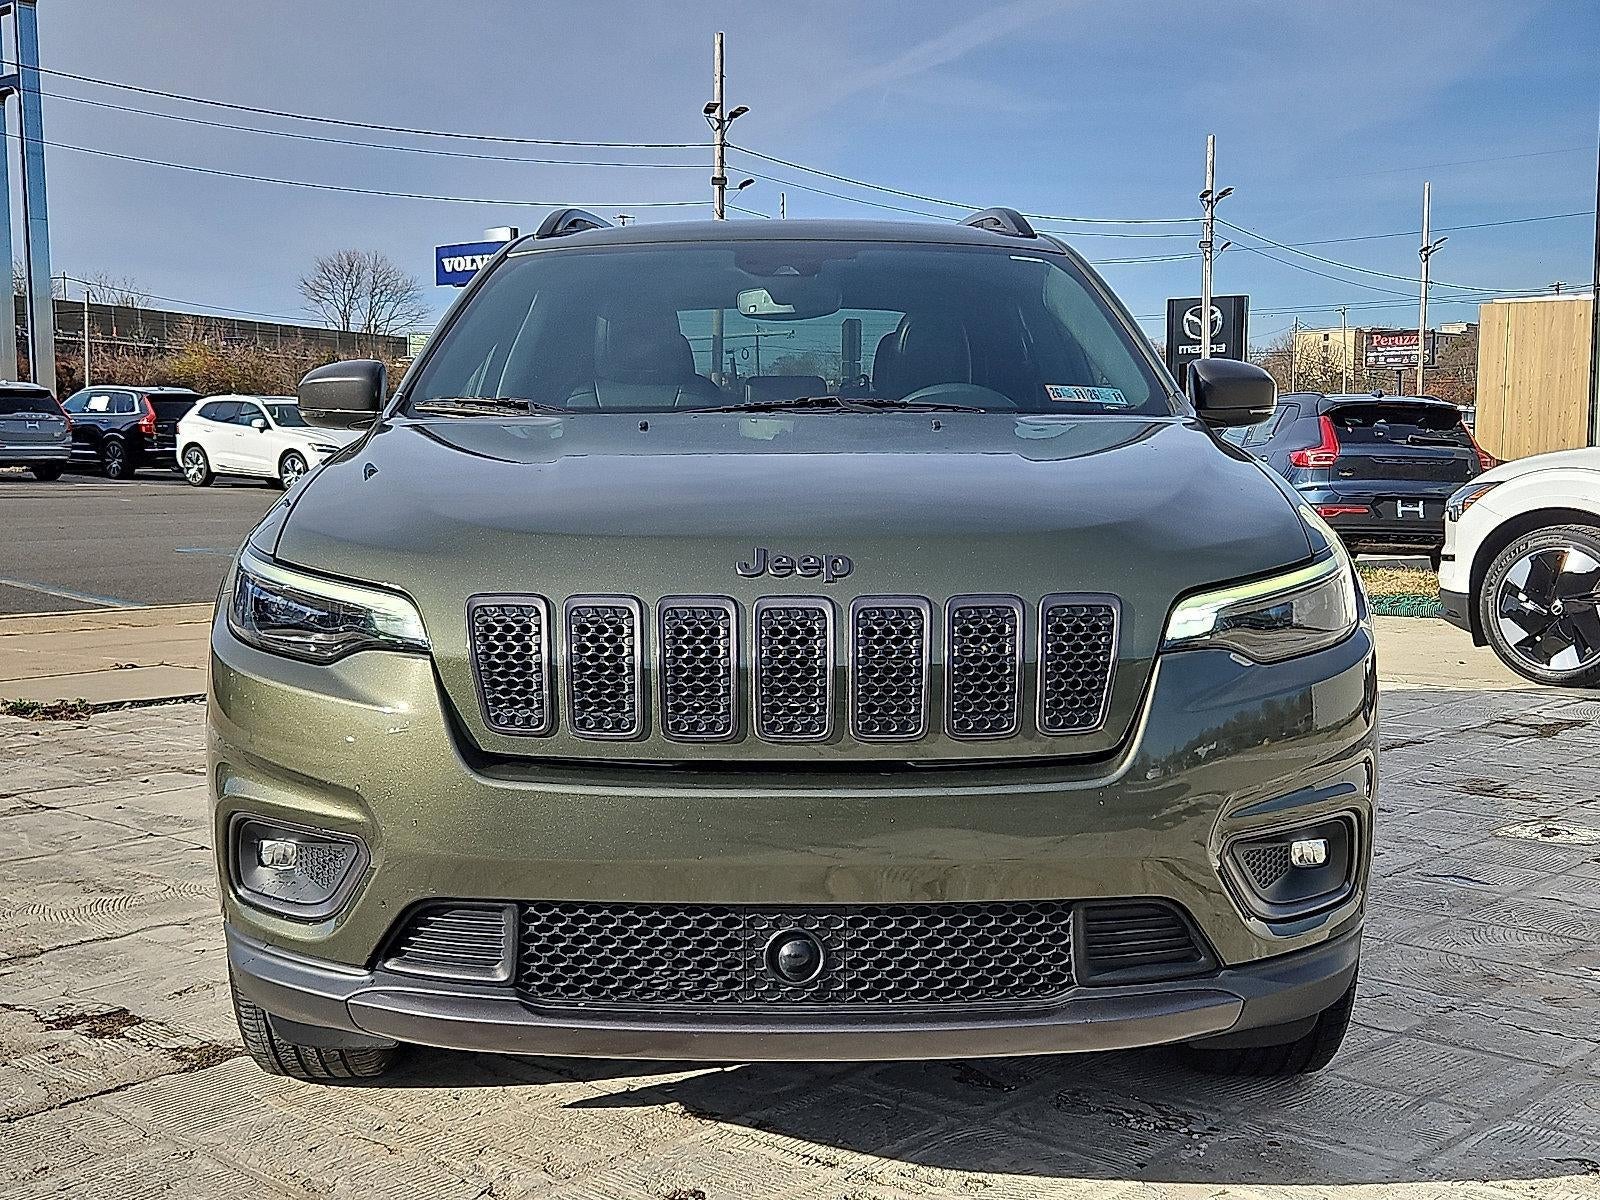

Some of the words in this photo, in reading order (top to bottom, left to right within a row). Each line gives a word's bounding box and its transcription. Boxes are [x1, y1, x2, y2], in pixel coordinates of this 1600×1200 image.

[442, 254, 494, 272] VOLV
[1178, 343, 1226, 354] mada
[735, 547, 853, 583] Jeep
[1490, 543, 1526, 584] MICHELIN
